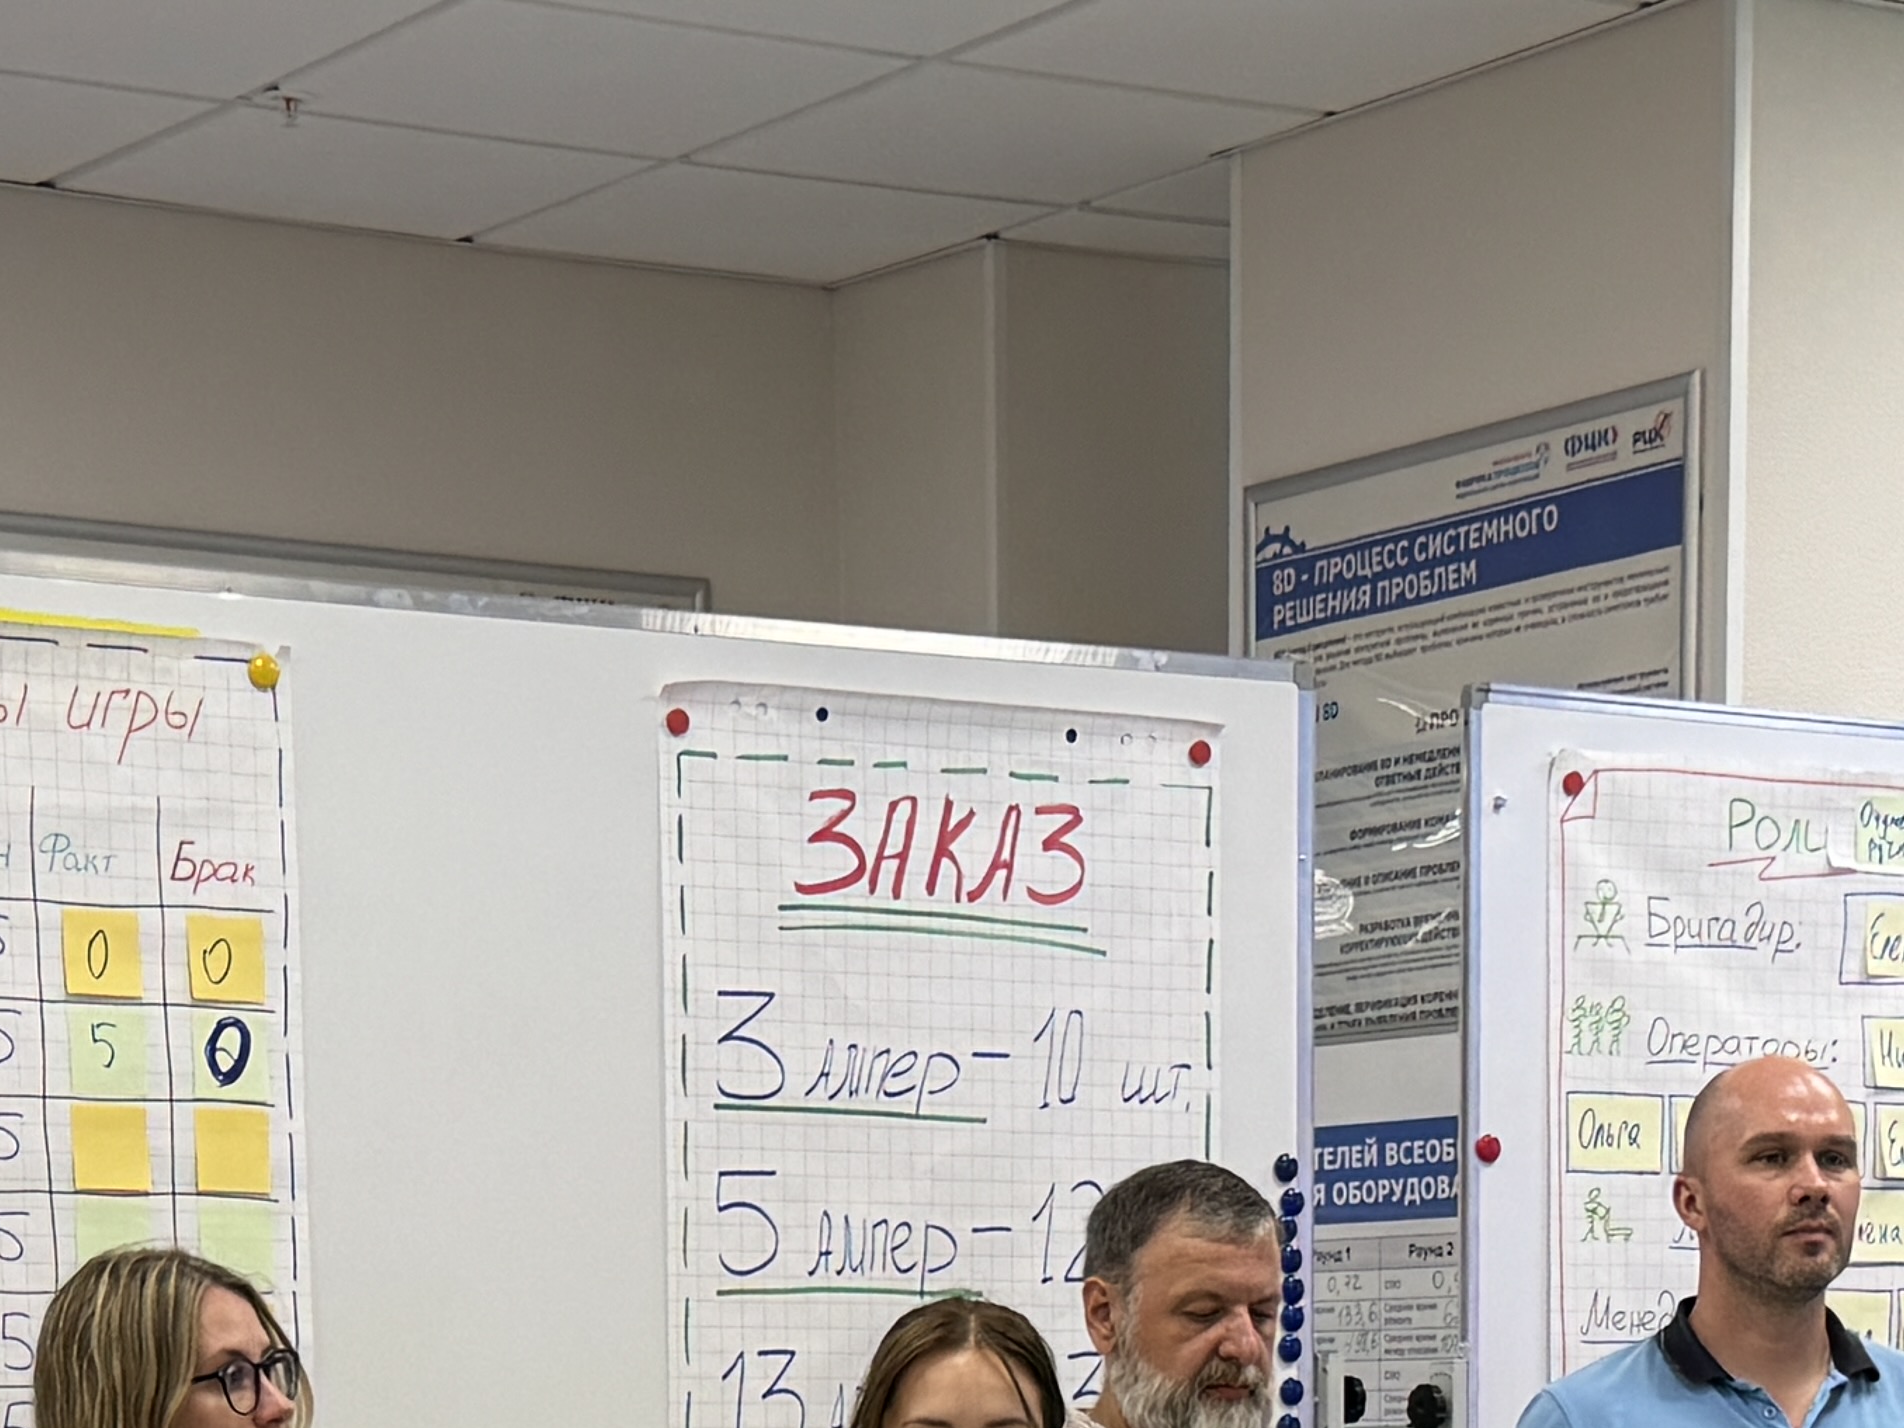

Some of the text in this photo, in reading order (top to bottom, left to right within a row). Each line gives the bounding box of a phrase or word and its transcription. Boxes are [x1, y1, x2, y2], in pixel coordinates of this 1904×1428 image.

[1272, 565, 1296, 596] 8D
[1314, 540, 1409, 588] ПРОЦЕСС
[1414, 504, 1558, 565] СИСТЕМНОГО
[1273, 583, 1371, 630] РЕШЕНИЯ
[1376, 560, 1477, 607] ПРОБЛЕМ
[67, 684, 204, 764] игры
[39, 831, 118, 875] Факт
[170, 840, 256, 894] Брак
[794, 787, 1086, 906] ЗАКАЗ
[87, 928, 109, 980] 0
[203, 937, 232, 986] 0
[90, 1021, 118, 1071] 5
[715, 989, 786, 1102] 3
[1033, 1007, 1084, 1111] 10
[1314, 1136, 1457, 1172] ТЕЛЕЙ ВСЕОБ
[1578, 1108, 1643, 1150] Ольга
[1313, 1173, 1460, 1208] Я ОБОРУДОВА
[716, 1169, 780, 1277] 5
[1446, 1241, 1455, 1257] 2
[1858, 1221, 1904, 1246] ена
[1581, 1290, 1677, 1337] Менед
